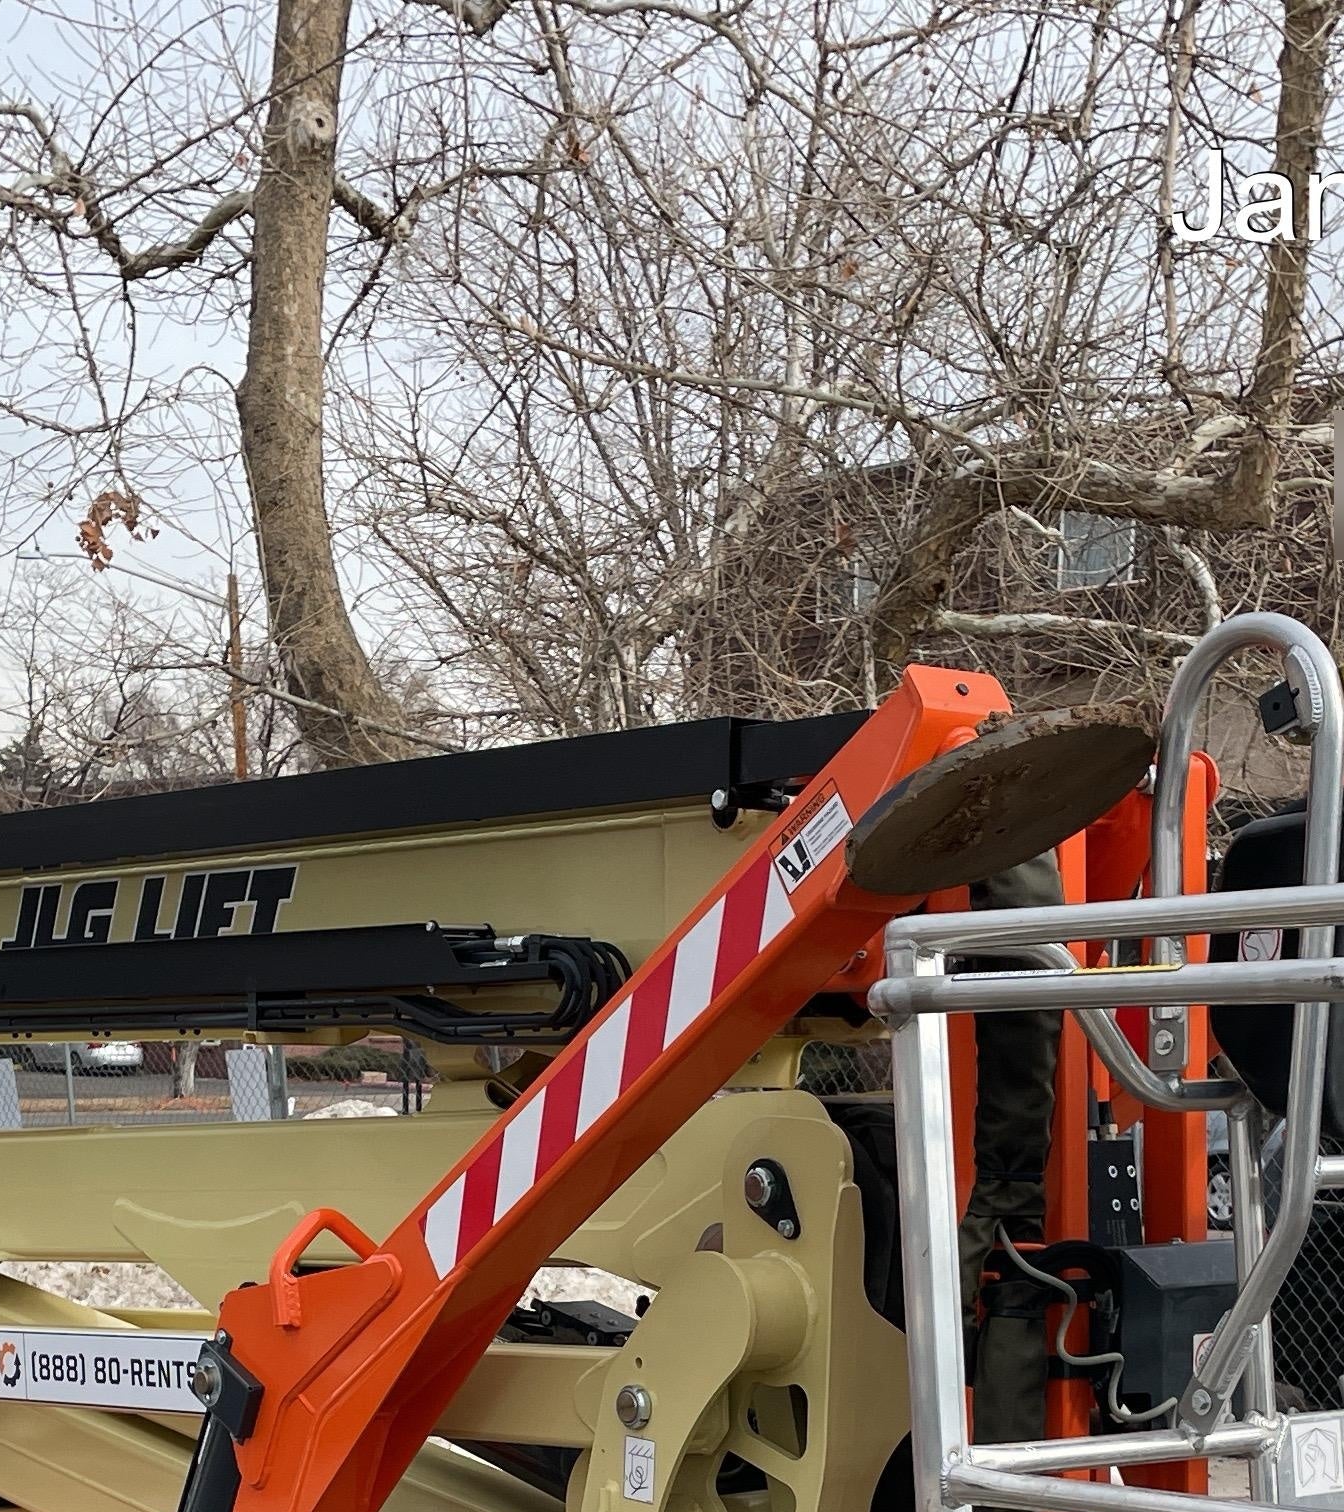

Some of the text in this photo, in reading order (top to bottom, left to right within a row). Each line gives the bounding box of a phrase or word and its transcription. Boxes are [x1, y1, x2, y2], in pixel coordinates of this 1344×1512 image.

[1, 863, 300, 950] JLG LIFT
[31, 1351, 86, 1386] (888)
